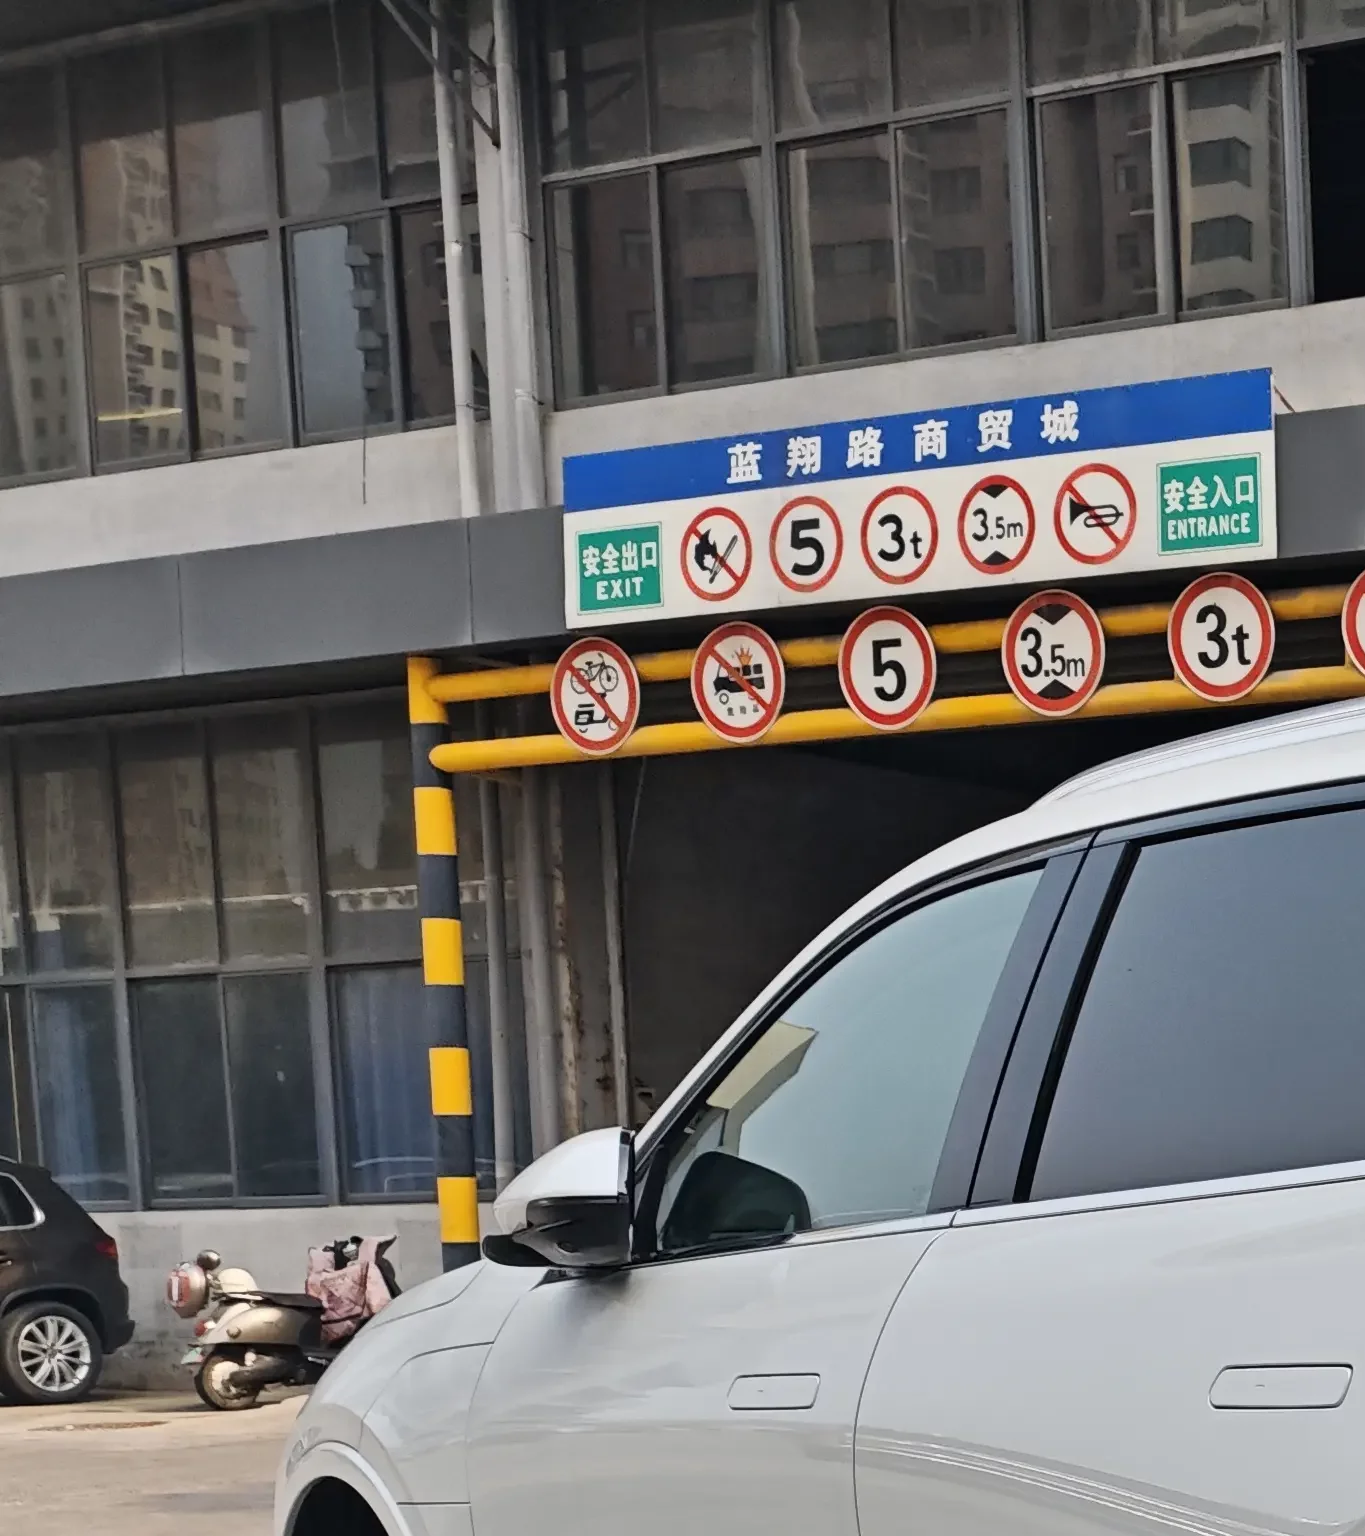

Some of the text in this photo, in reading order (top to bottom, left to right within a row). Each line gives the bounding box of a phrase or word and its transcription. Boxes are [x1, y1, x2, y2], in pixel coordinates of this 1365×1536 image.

[726, 400, 1080, 485] 蓝翔路商贸城
[1163, 474, 1255, 514] 安全入口
[790, 518, 825, 577] 5
[877, 513, 923, 563] 3t
[971, 508, 1024, 542] 3.5m
[1167, 512, 1251, 540] ENTRANCE
[582, 540, 657, 577] 安全出口
[596, 576, 644, 600] EXIT
[1020, 627, 1086, 679] 3.5m
[1196, 602, 1252, 669] 3t
[872, 637, 907, 702] 5
